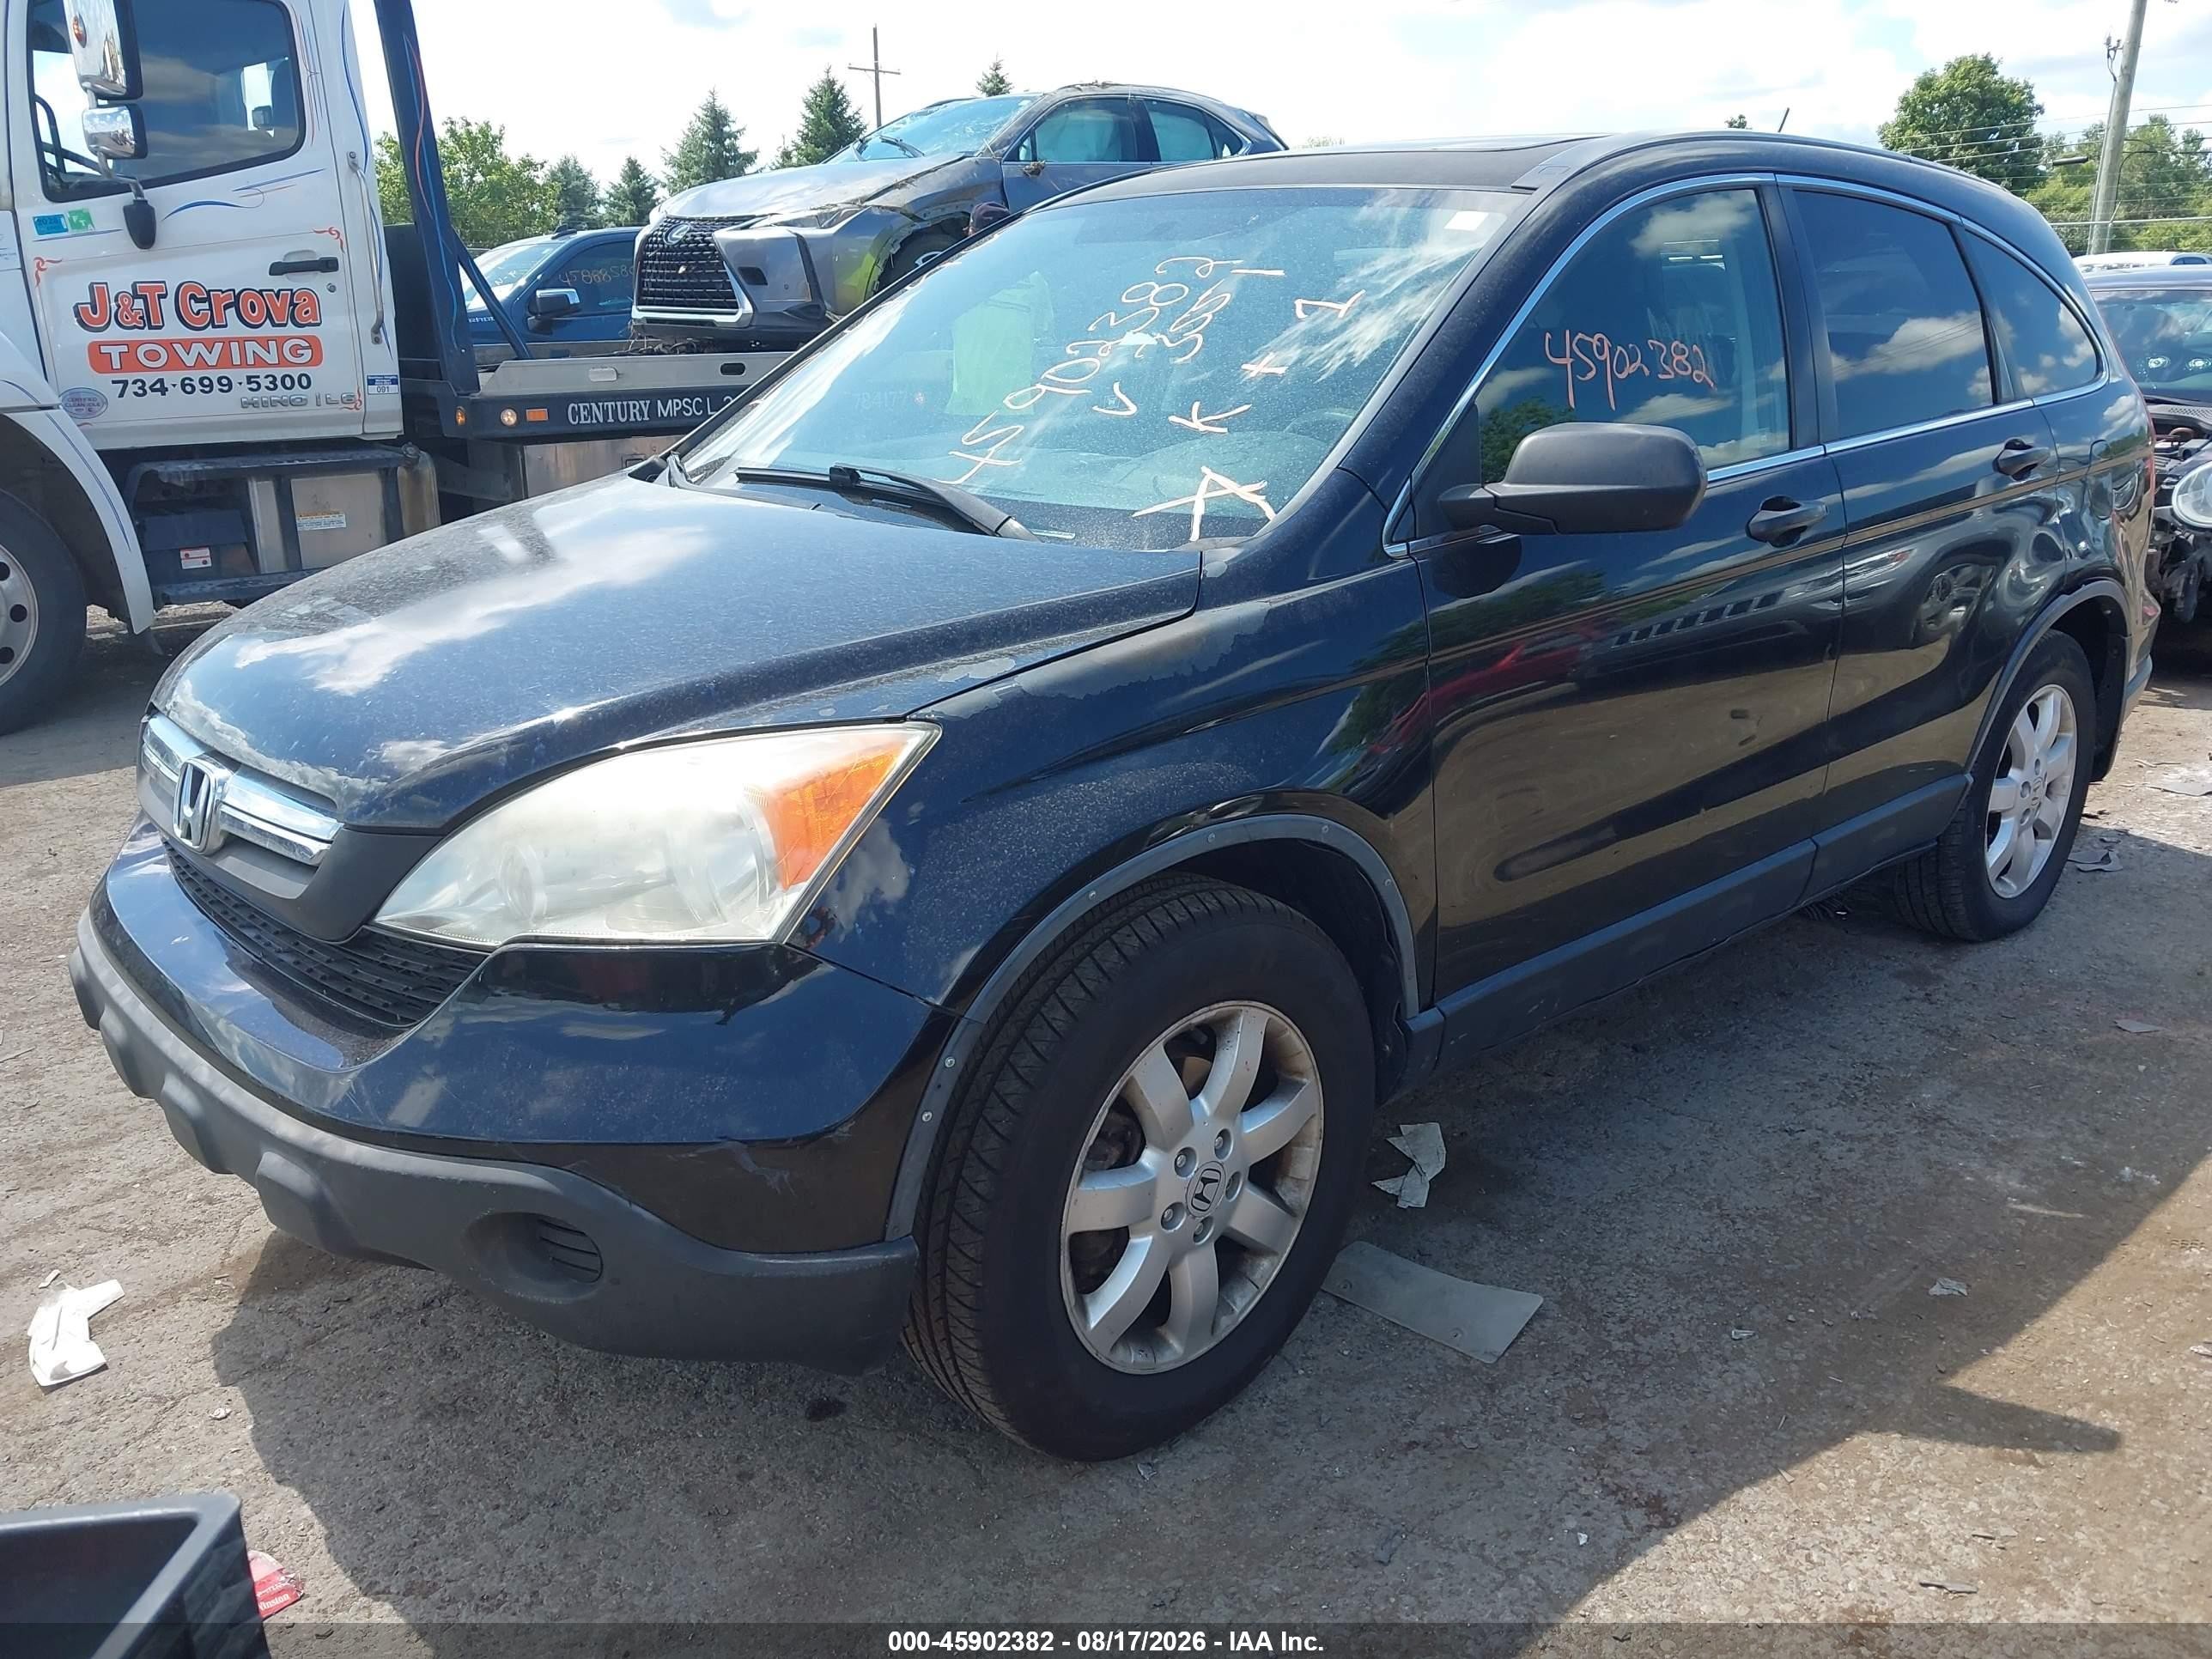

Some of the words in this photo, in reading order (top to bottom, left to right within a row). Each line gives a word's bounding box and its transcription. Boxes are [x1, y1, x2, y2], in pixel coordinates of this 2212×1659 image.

[73, 280, 168, 332] J&T
[174, 281, 323, 331] Crova
[98, 337, 314, 371] TOWING
[1545, 328, 1717, 410] 45902382
[240, 393, 308, 409] HINO
[568, 400, 651, 425] CENTURY
[657, 397, 703, 418] MPSC
